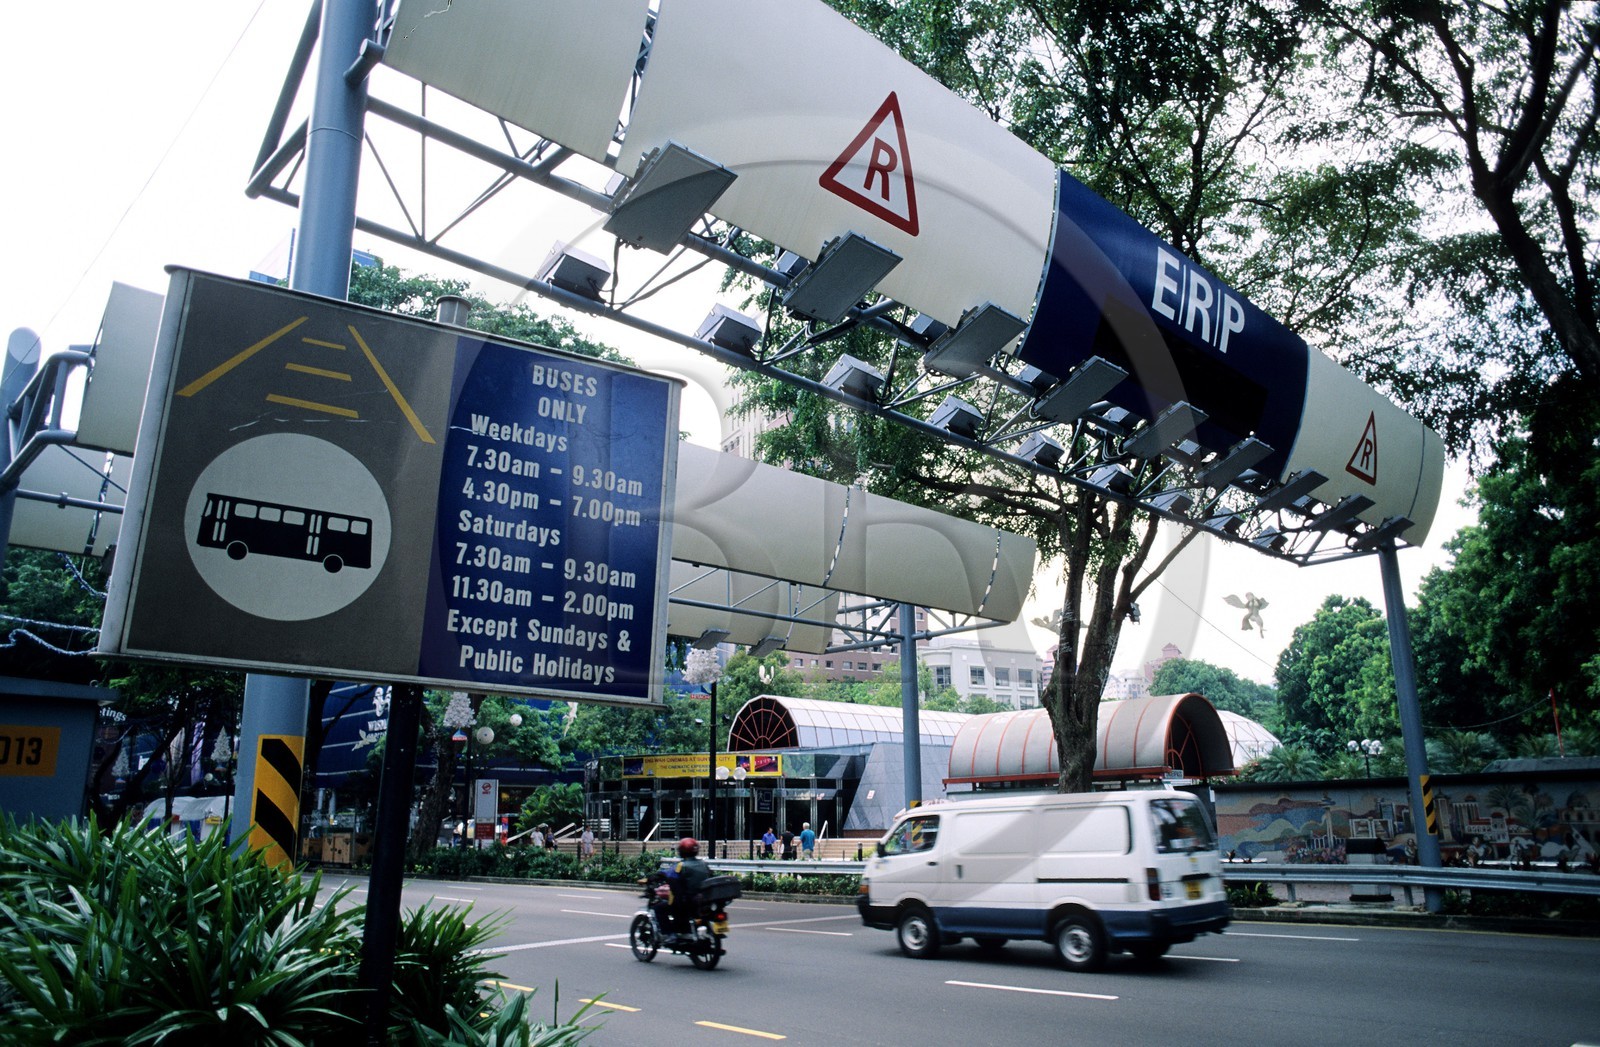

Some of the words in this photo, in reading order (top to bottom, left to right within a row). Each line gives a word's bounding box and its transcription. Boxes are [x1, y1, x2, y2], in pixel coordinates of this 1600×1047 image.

[863, 136, 898, 202] R
[532, 364, 598, 397] BUSES
[538, 396, 587, 425] ONLY
[471, 413, 567, 453] Weekdays
[1360, 437, 1374, 472] R
[467, 444, 540, 479] 7.30am
[572, 465, 643, 497] 9.30am
[462, 476, 540, 510] 4.30pm
[572, 495, 641, 527] 7.00pm
[458, 509, 561, 547] Saturdays
[456, 541, 531, 574] 7.30am
[563, 558, 636, 589] 9.30am
[452, 574, 532, 607] 11.30am
[563, 590, 634, 622] 2.00pm
[446, 608, 518, 641] Except
[527, 618, 608, 652] Sundays
[617, 629, 631, 652] &
[459, 644, 523, 674] Public
[532, 652, 615, 686] Holidays
